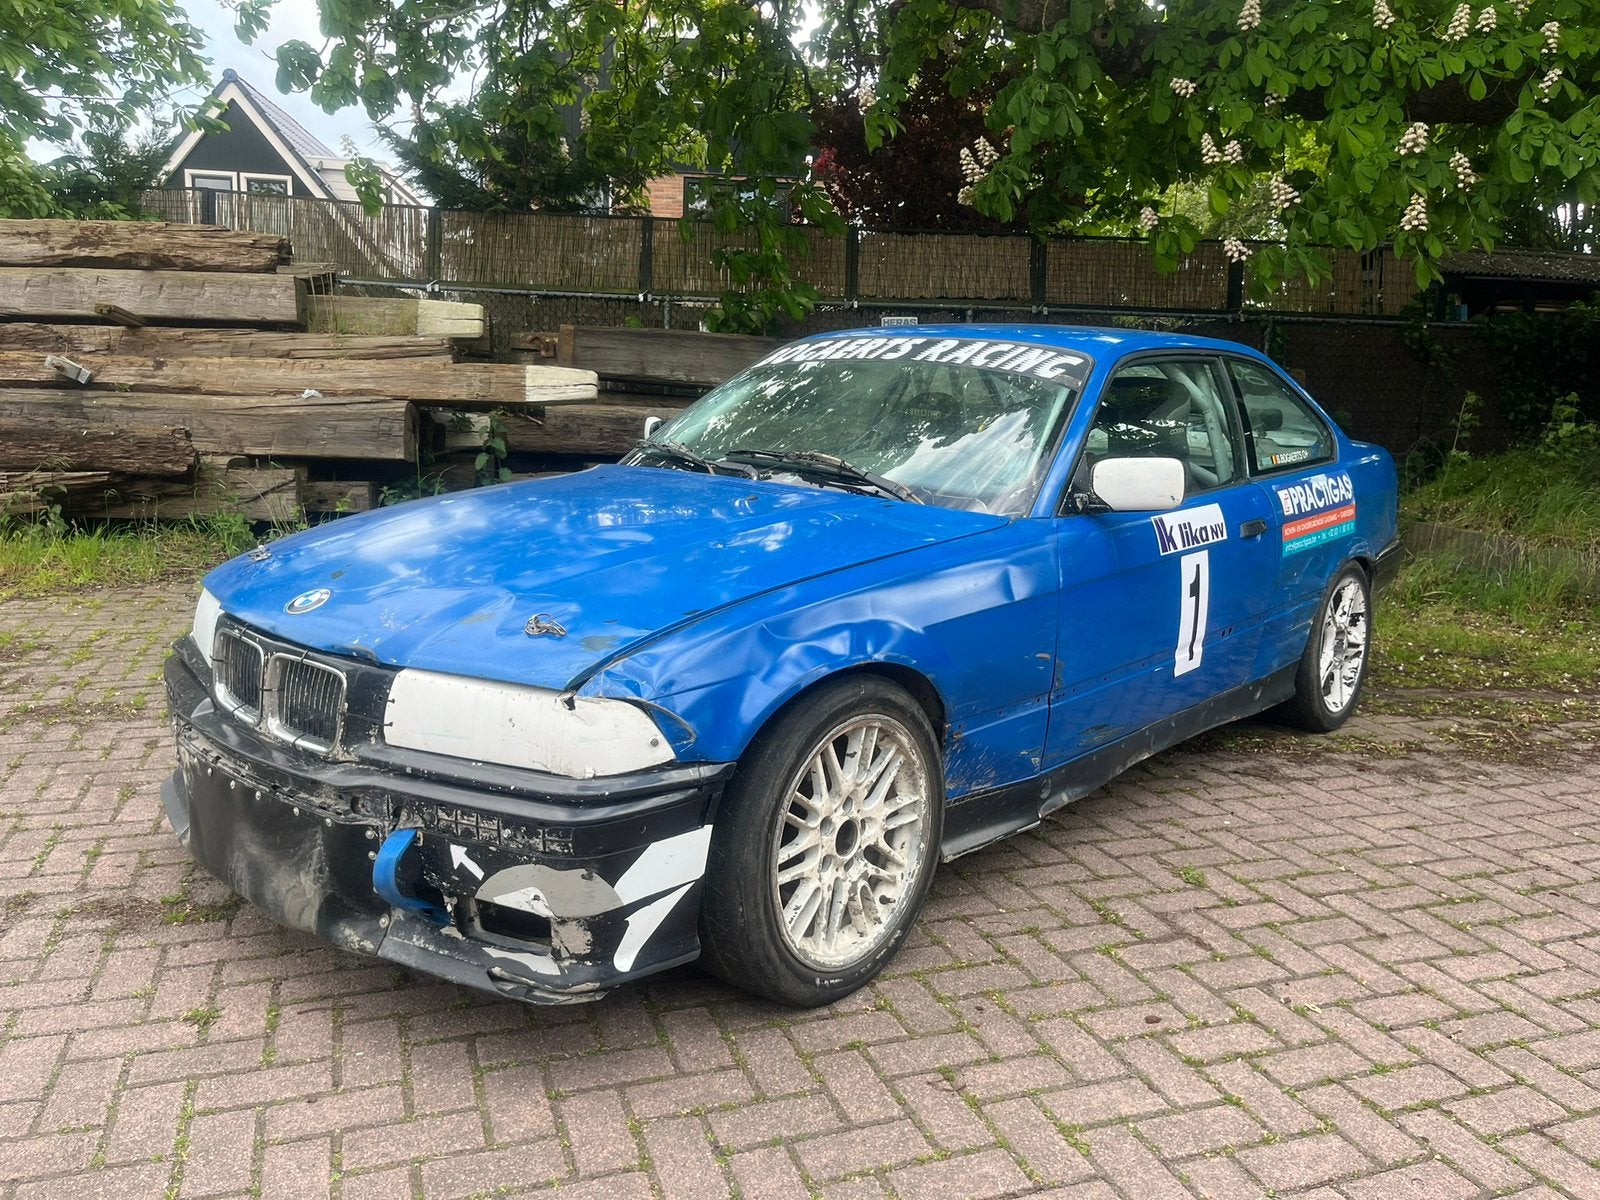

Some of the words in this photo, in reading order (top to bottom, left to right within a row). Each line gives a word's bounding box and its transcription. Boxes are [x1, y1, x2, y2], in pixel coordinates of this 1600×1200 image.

[883, 318, 916, 326] HERAS
[911, 339, 1084, 379] RACING
[1288, 475, 1353, 515] PRACTIGAS
[1210, 522, 1224, 541] NV
[1188, 564, 1200, 661] 1
